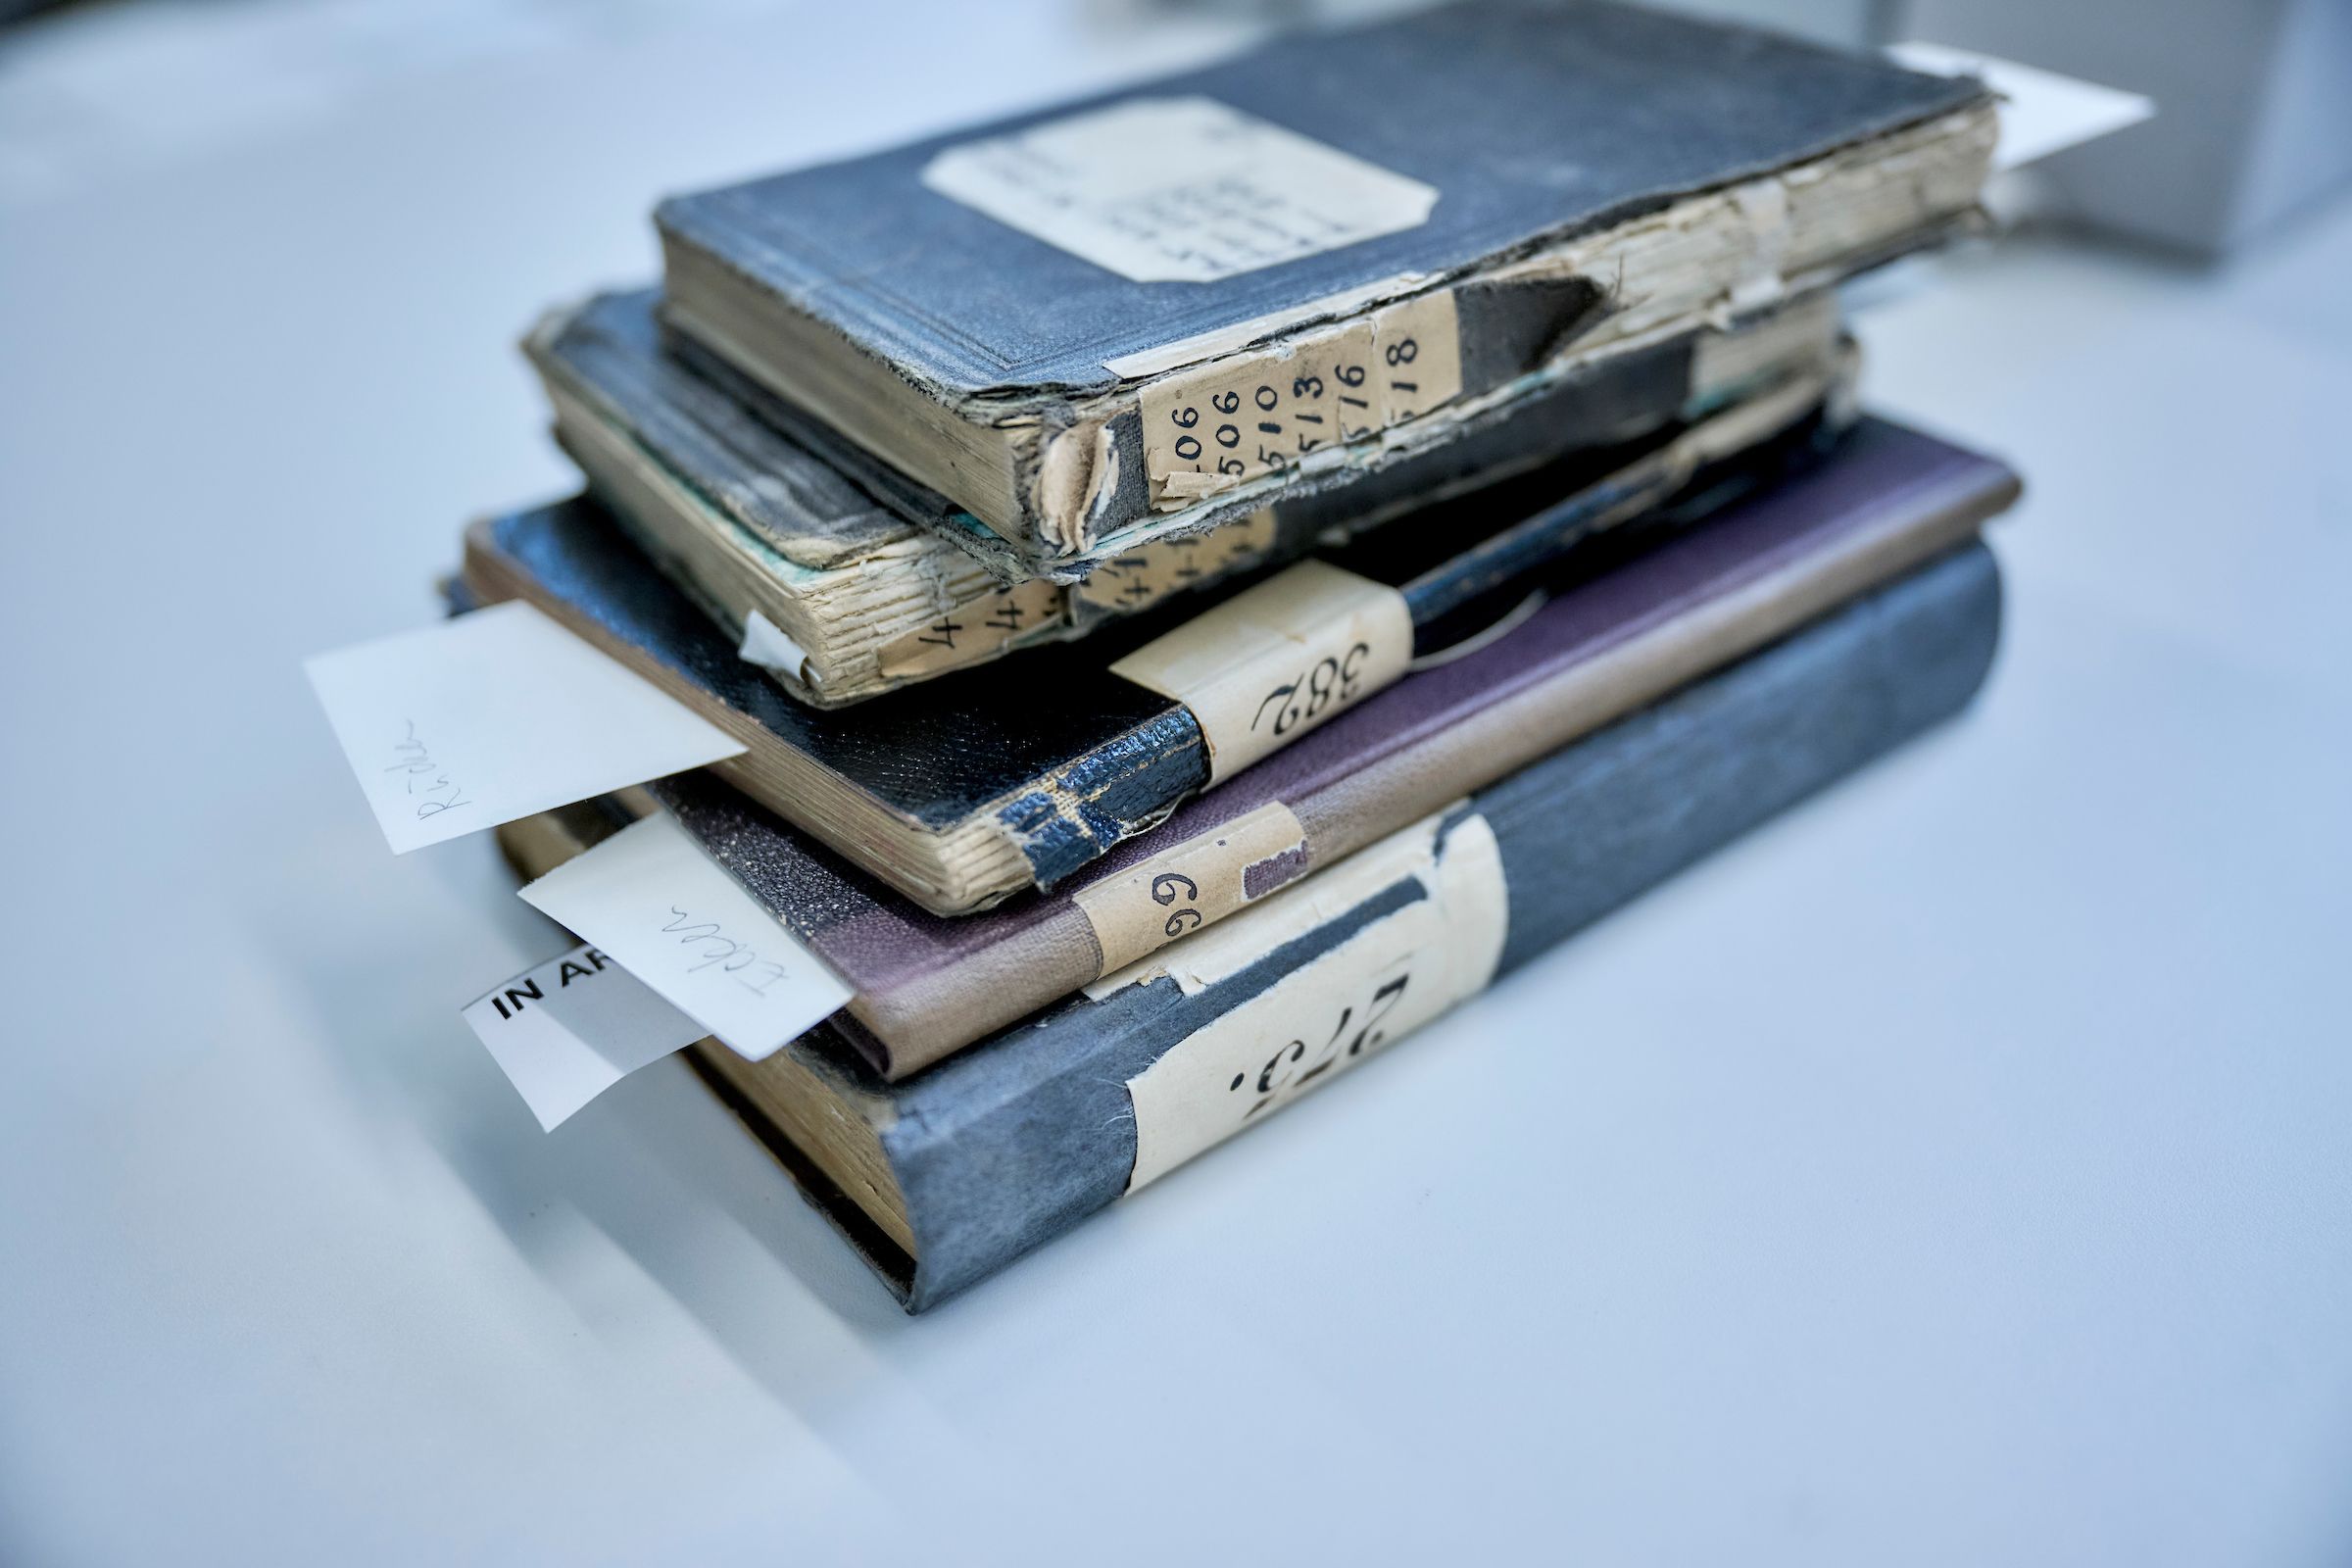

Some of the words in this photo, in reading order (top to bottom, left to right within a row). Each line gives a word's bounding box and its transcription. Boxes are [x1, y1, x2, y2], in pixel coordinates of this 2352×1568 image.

[1172, 407, 1201, 472] 06
[1213, 391, 1245, 477] 506
[1255, 385, 1286, 469] 510
[1251, 642, 1369, 735] 382
[491, 977, 545, 1020] IN
